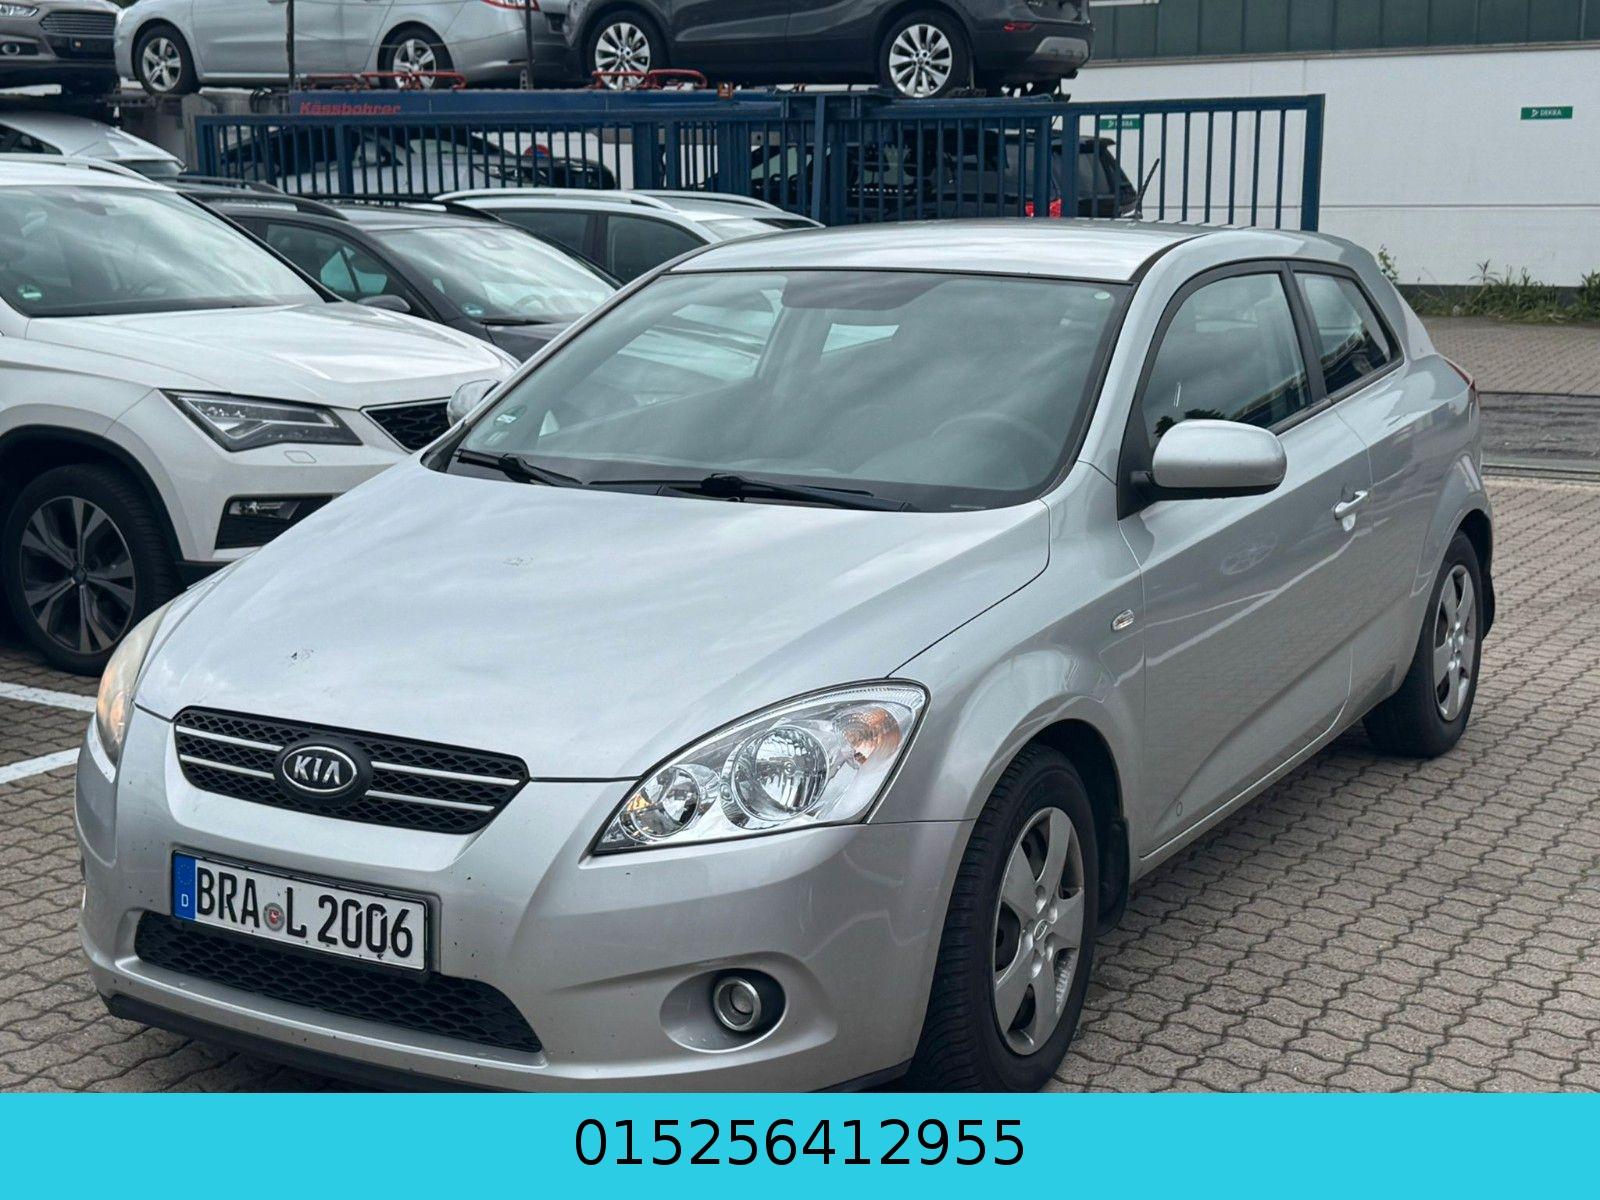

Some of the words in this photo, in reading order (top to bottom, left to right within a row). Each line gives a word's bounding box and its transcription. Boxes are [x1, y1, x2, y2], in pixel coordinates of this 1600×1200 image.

[294, 755, 341, 785] KIA
[181, 893, 189, 907] D
[197, 866, 260, 928] BRA
[286, 886, 307, 938] L
[317, 894, 413, 958] 2006
